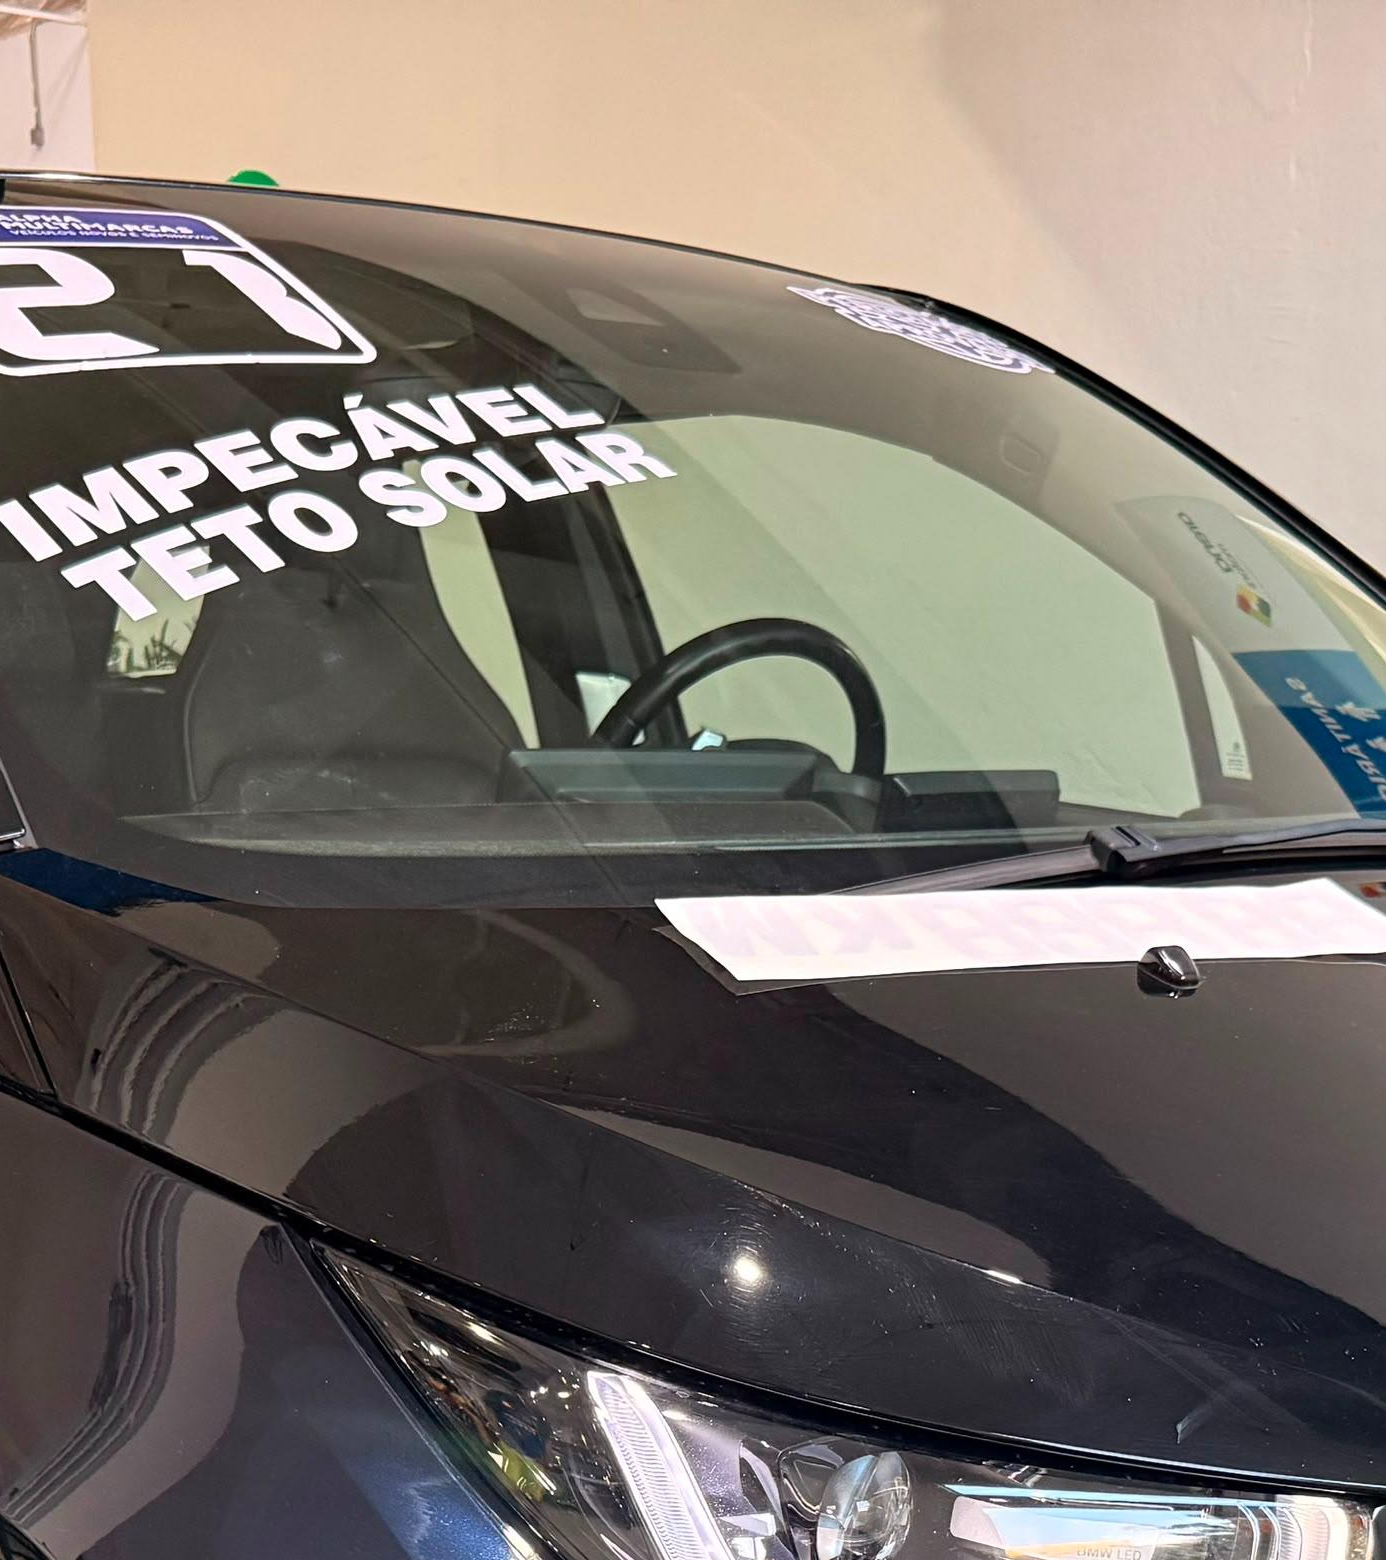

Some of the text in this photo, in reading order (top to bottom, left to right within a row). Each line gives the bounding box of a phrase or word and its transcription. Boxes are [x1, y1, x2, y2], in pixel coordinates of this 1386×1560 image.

[0, 221, 194, 235] MULTIMARCAS
[60, 430, 679, 622] TETO SOLAR
[1116, 1548, 1142, 1560] LED
